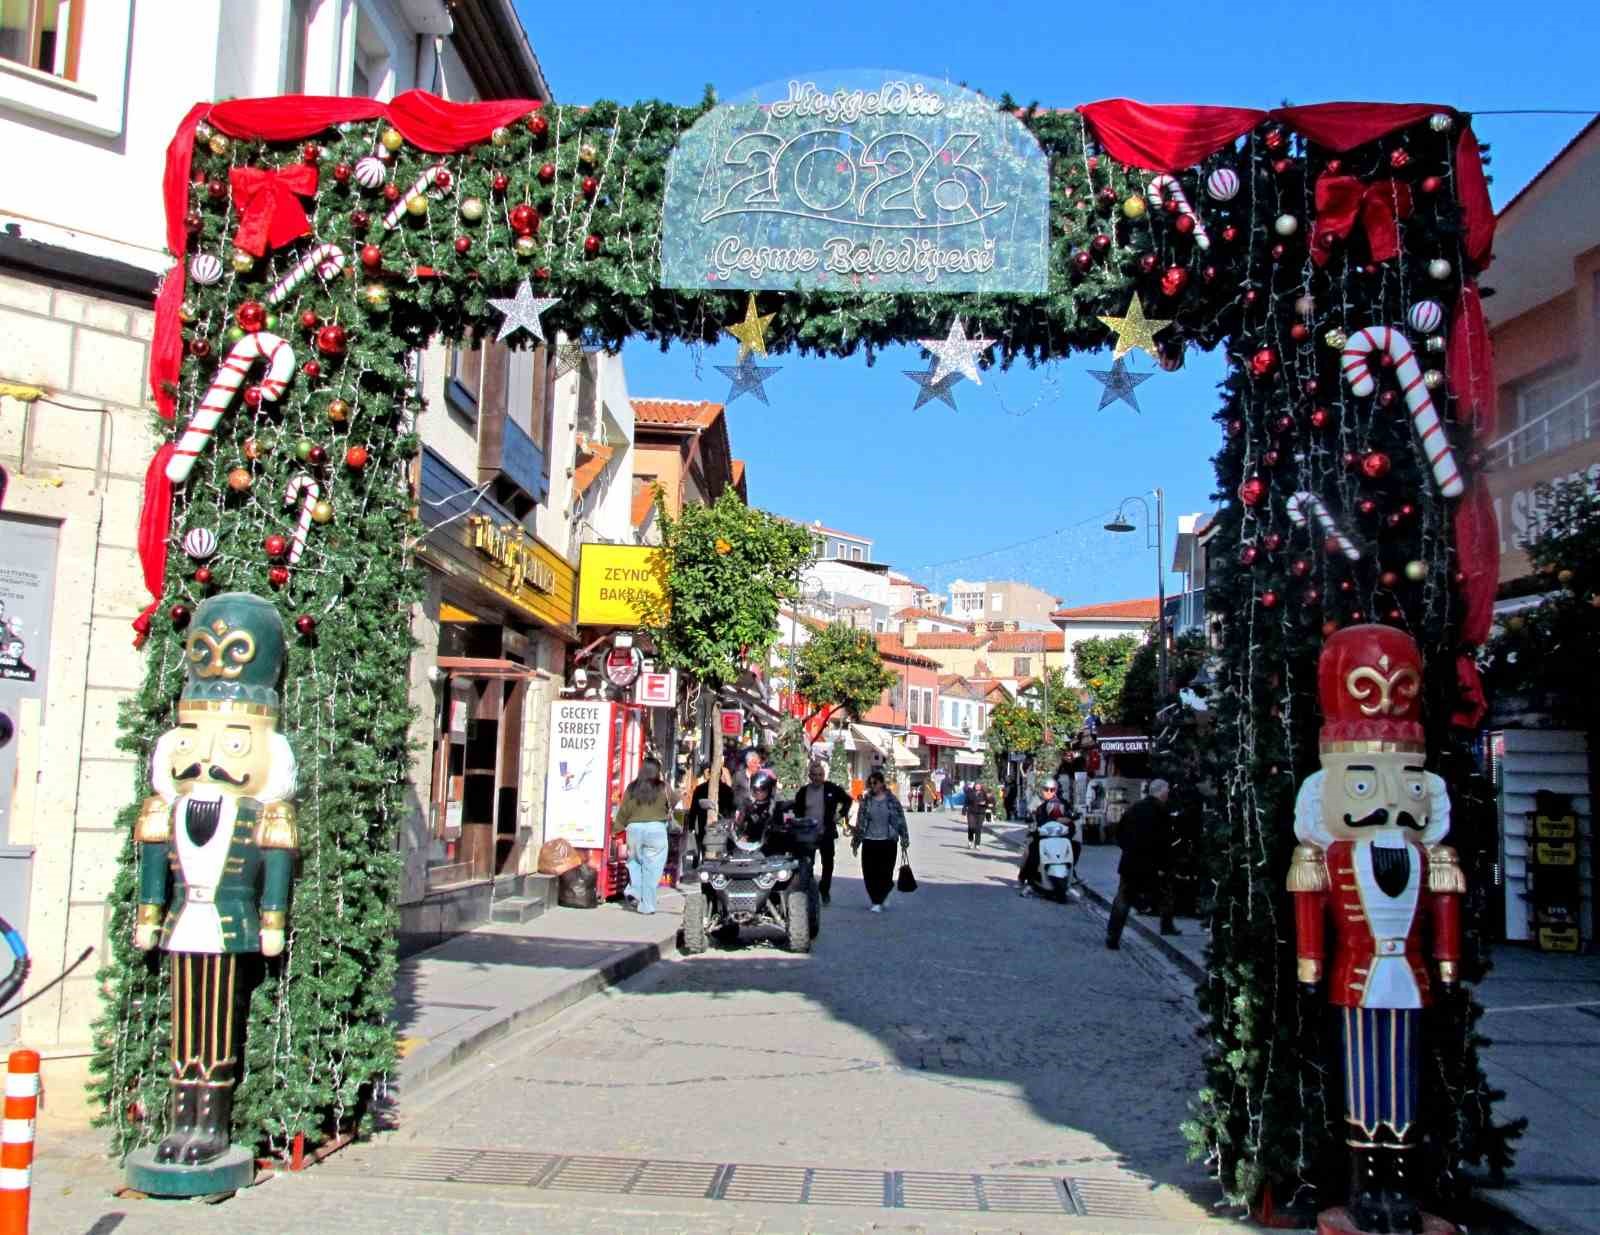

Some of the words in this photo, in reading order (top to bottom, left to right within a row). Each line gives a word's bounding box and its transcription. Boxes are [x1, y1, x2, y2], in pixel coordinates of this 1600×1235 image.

[701, 128, 1008, 228] 2026
[715, 235, 819, 281] Çeşme
[823, 236, 995, 282] Belediyesi
[604, 567, 650, 582] ZEYNO
[561, 706, 600, 720] GECEYE
[558, 721, 601, 735] SERBEST
